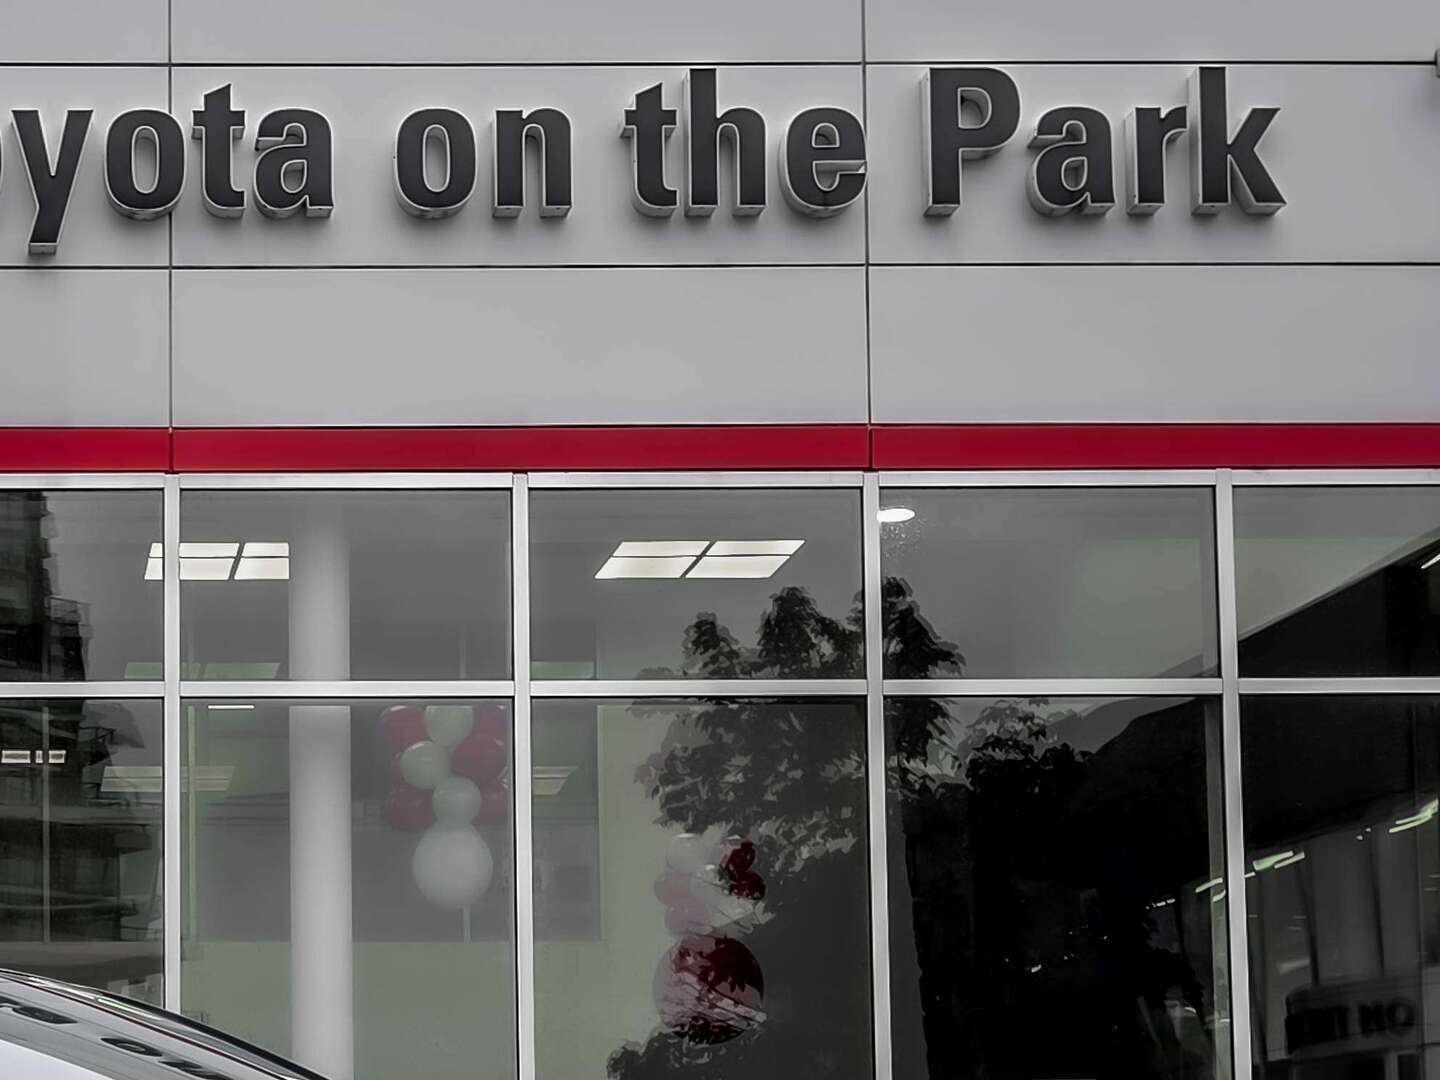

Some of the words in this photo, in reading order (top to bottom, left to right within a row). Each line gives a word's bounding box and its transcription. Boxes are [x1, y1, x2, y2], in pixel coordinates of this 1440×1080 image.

[394, 106, 573, 220] on
[619, 67, 868, 220] the
[920, 66, 1288, 220] Park
